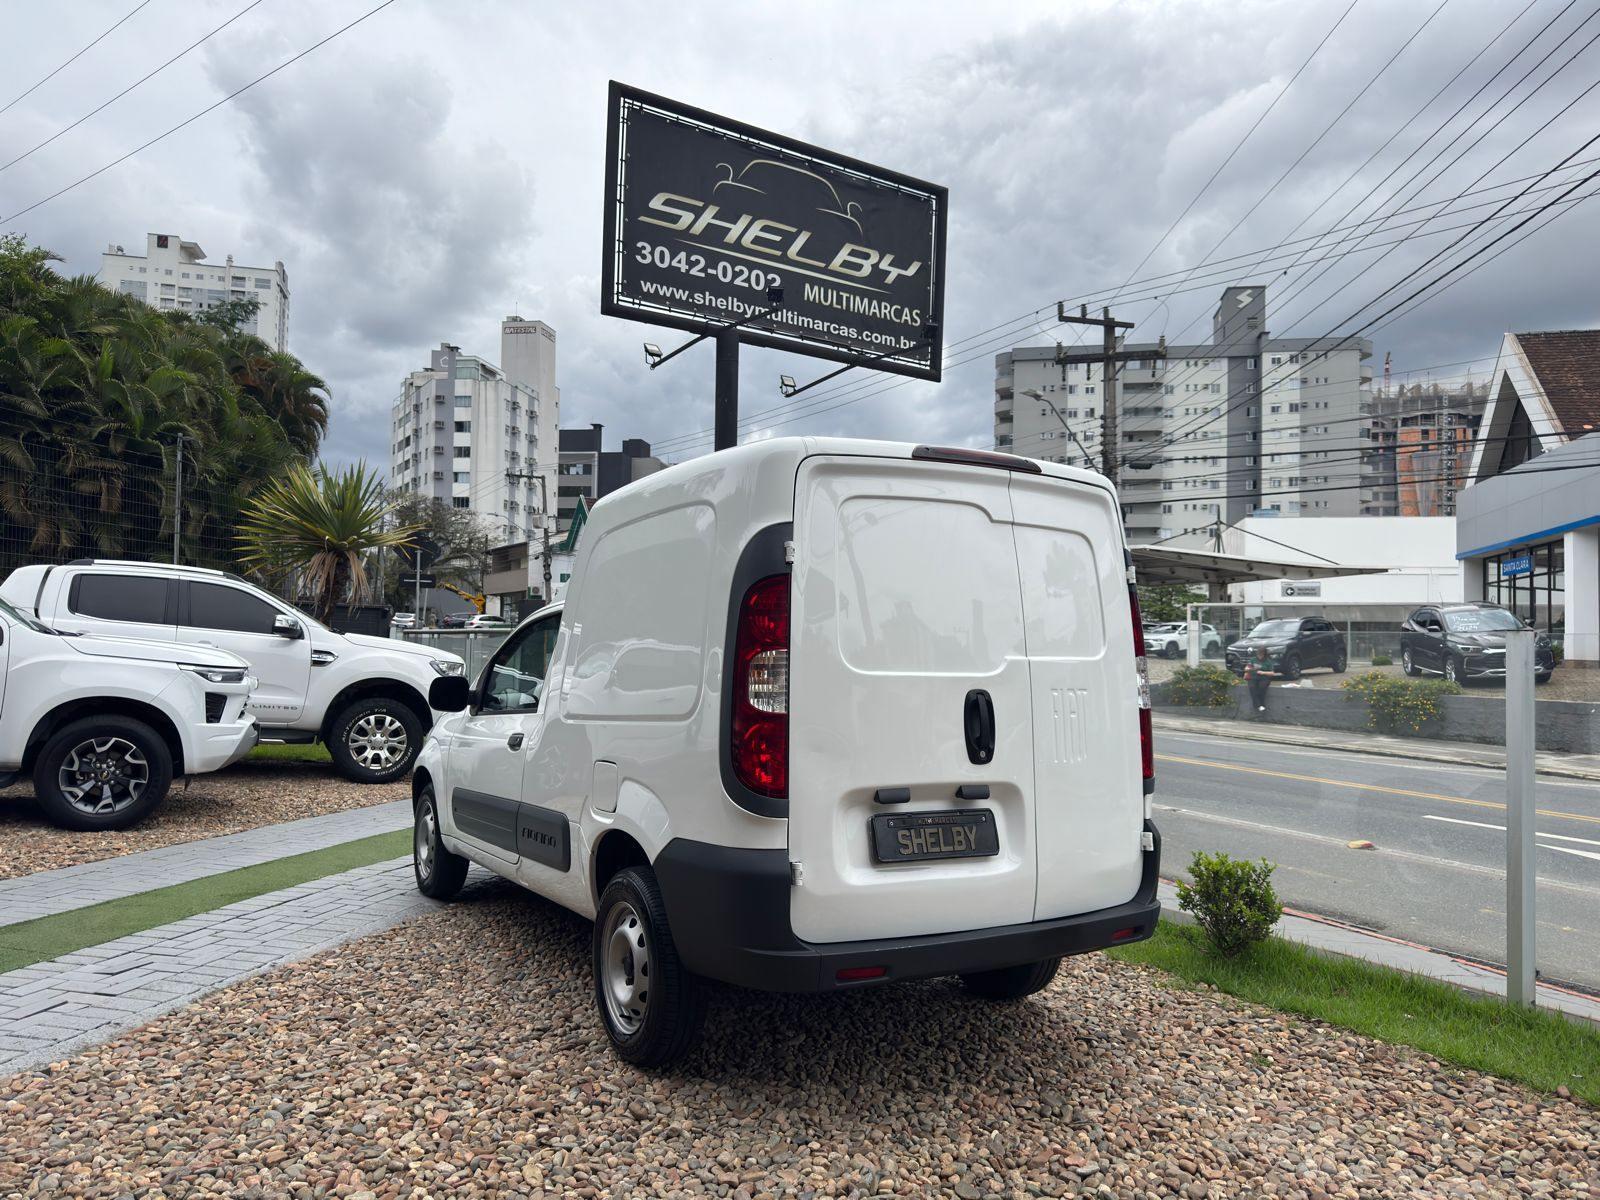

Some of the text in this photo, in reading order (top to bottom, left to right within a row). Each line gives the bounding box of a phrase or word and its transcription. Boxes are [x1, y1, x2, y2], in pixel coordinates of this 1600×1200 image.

[637, 191, 922, 285] SHELBY
[804, 282, 921, 328] MULTIMARCAS
[897, 825, 977, 855] SHELBY
